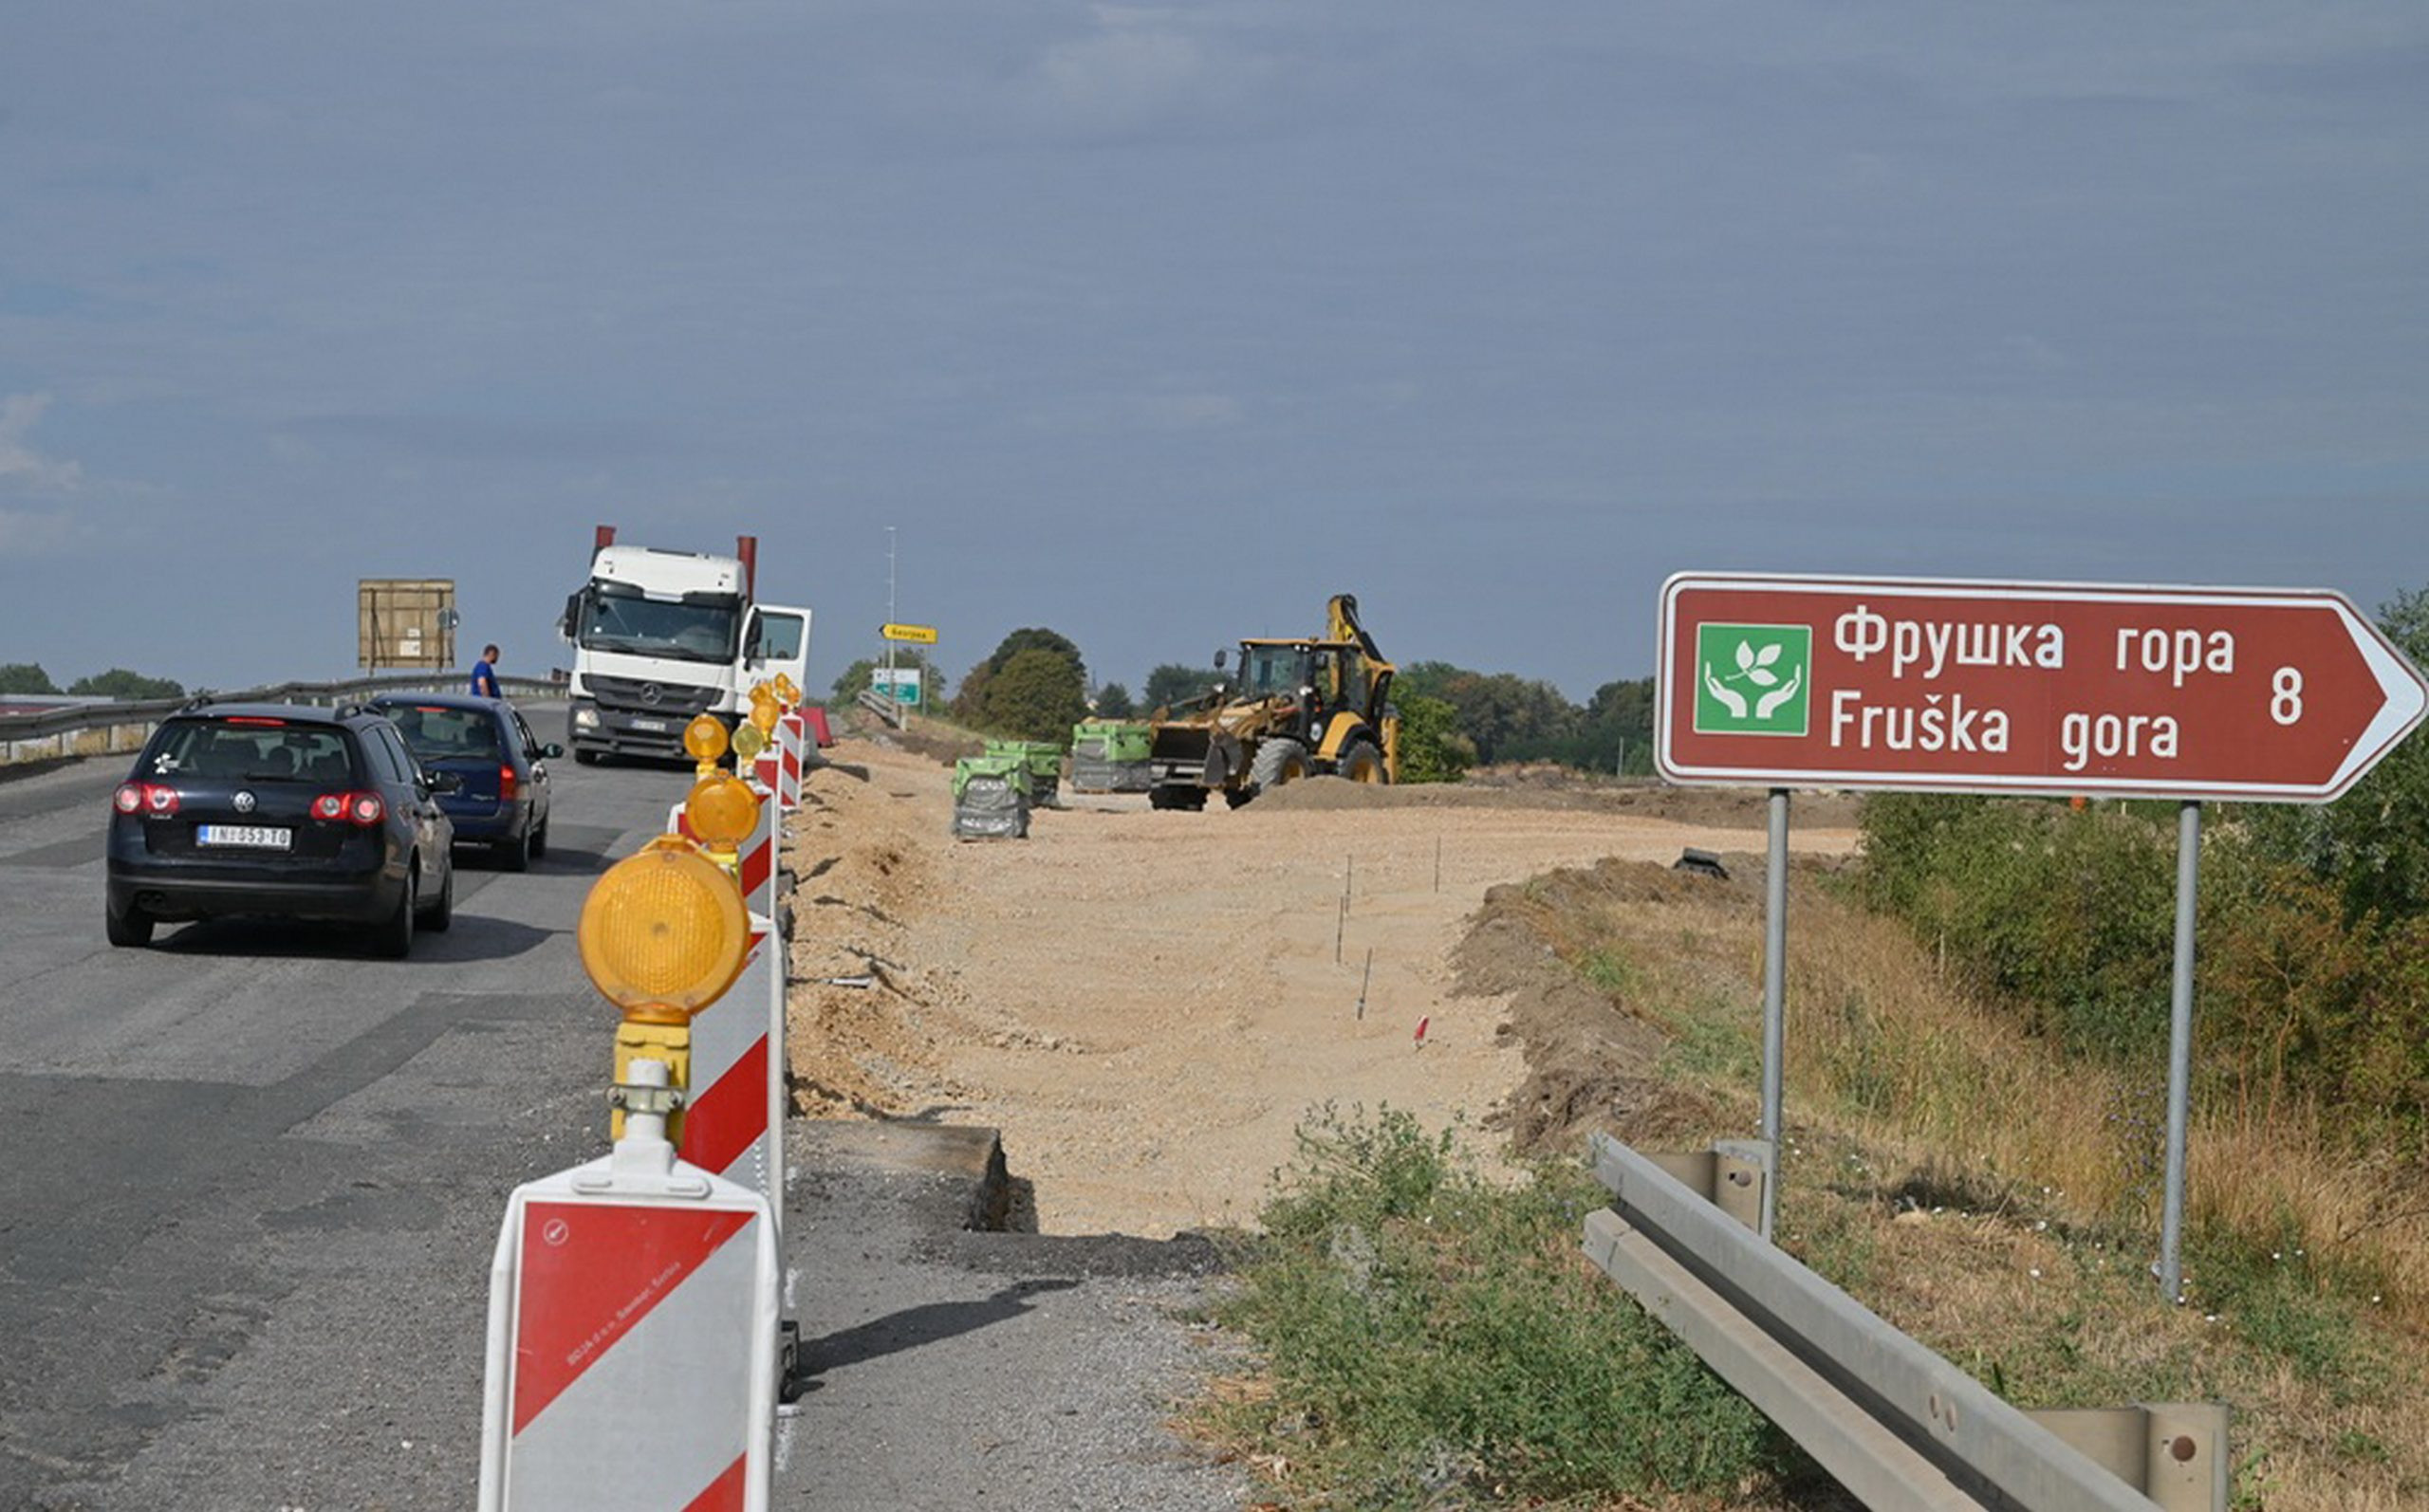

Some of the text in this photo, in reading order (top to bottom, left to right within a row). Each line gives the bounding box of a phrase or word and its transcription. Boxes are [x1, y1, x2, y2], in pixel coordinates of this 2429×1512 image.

[1833, 605, 2235, 688] Фрушка гора
[1830, 689, 2179, 771] Fruška gora
[2270, 665, 2303, 726] 8
